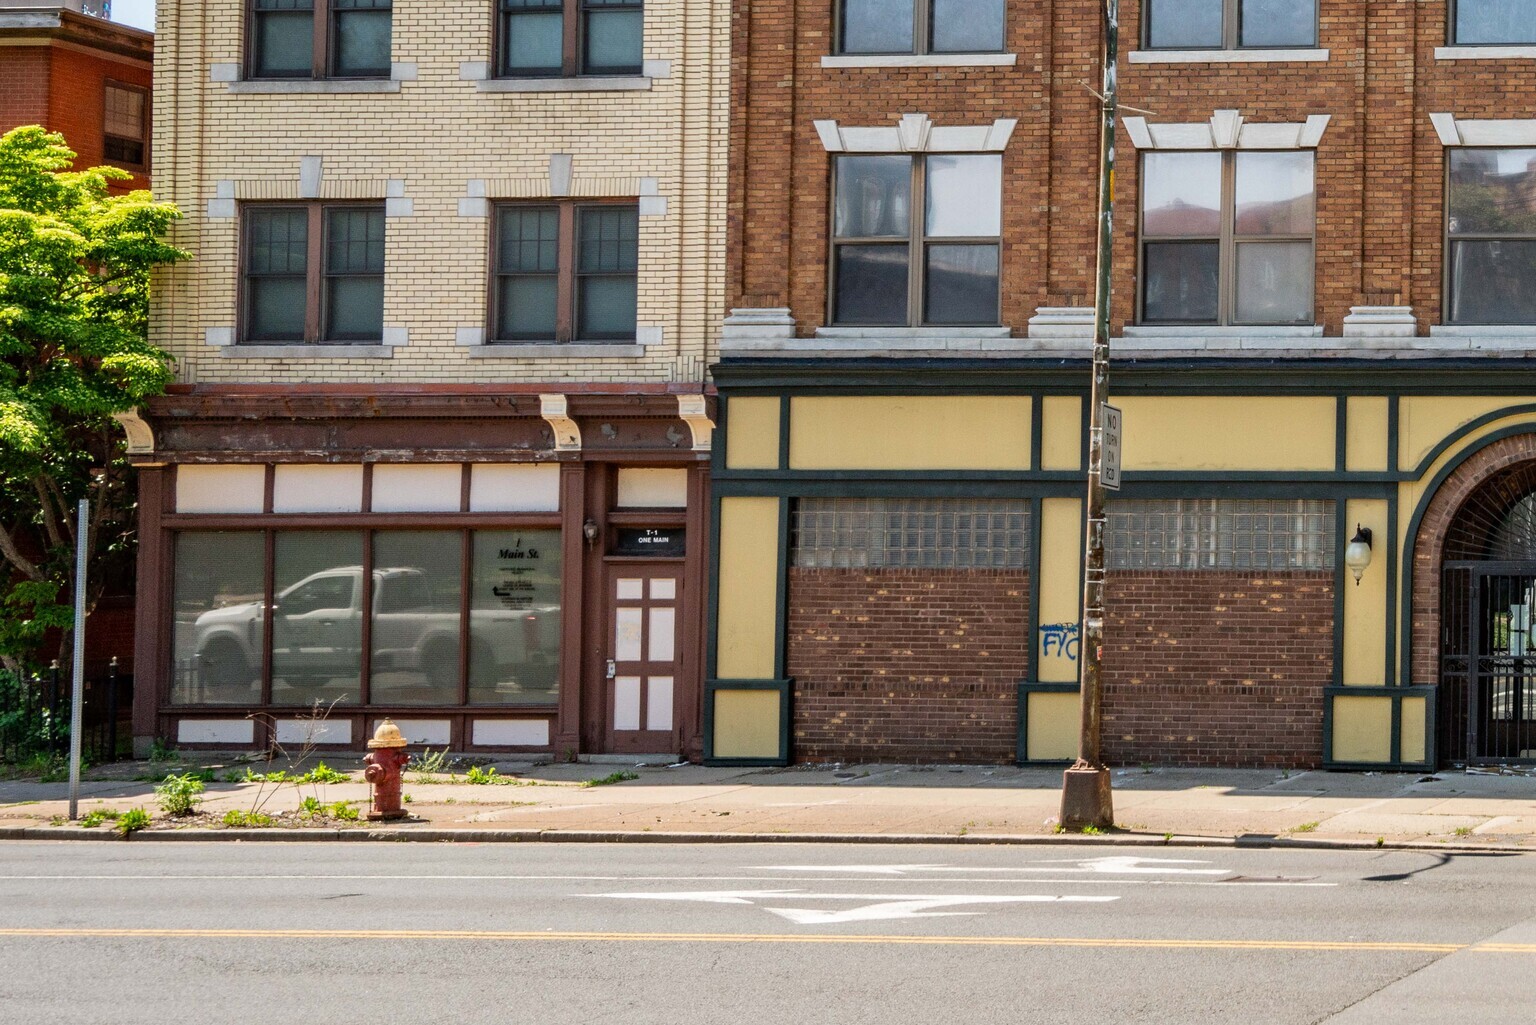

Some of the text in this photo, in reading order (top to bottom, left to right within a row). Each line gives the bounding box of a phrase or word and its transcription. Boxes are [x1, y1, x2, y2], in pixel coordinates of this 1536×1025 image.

[1107, 413, 1117, 430] NO
[497, 549, 539, 559] Main St.
[1043, 632, 1080, 661] FYC
